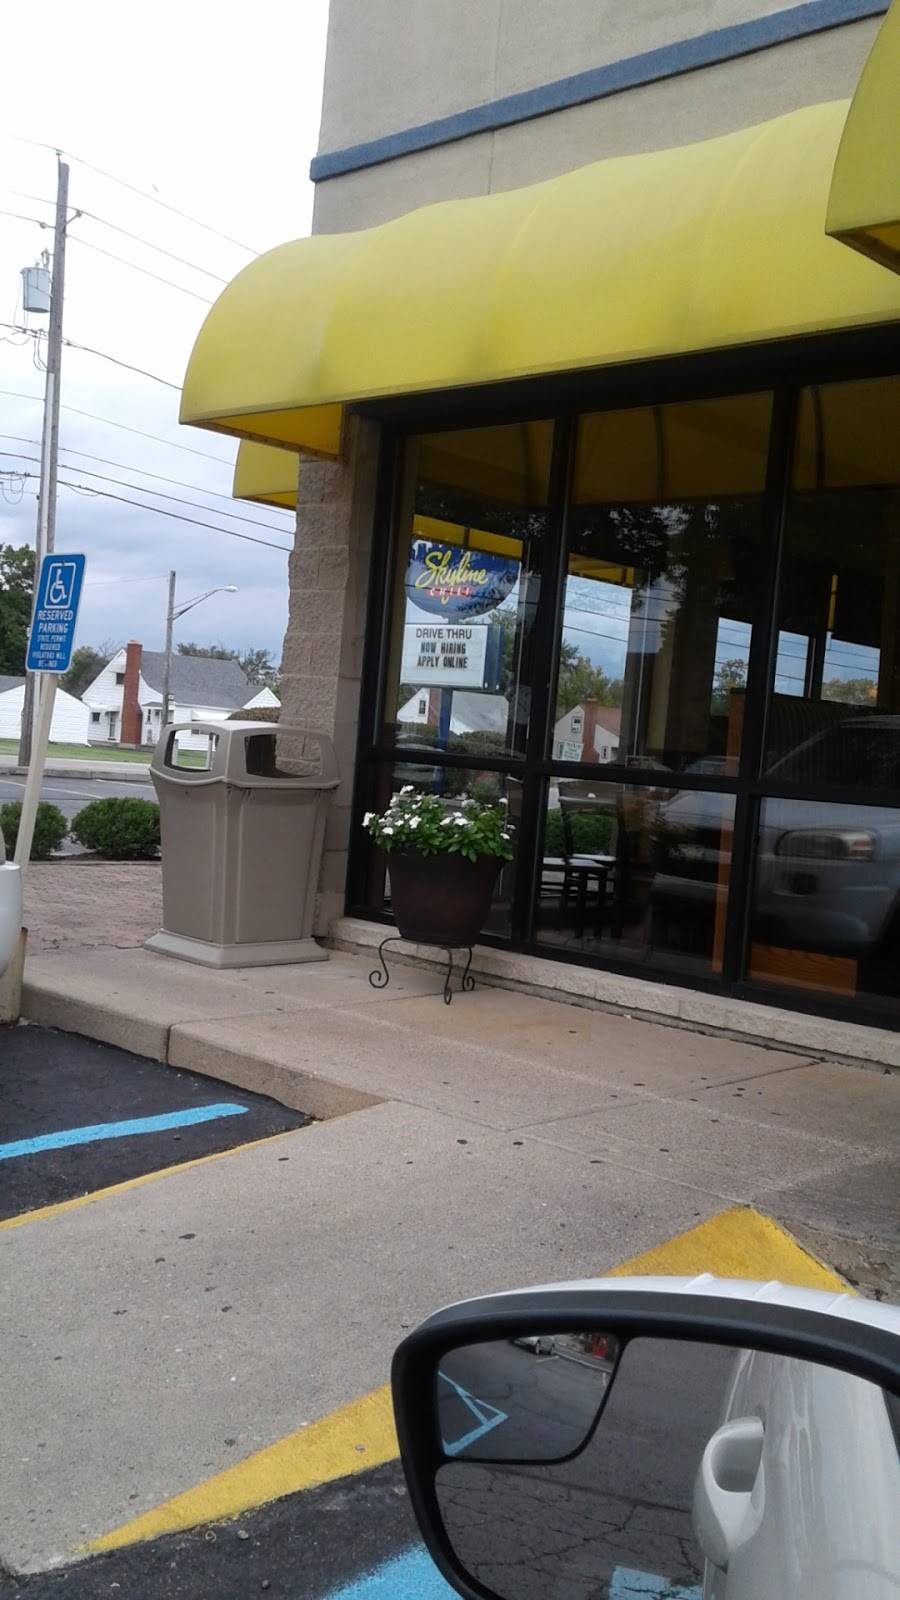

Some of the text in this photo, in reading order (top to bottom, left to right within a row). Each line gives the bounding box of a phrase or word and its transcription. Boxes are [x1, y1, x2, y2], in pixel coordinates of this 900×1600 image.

[415, 550, 488, 605] Skyline
[37, 610, 74, 621] RESERVED
[38, 623, 69, 633] PARKING
[416, 628, 472, 639] DRIVE THRU
[420, 642, 466, 654] NOW HIRING
[417, 656, 468, 669] APPLY ONLINE
